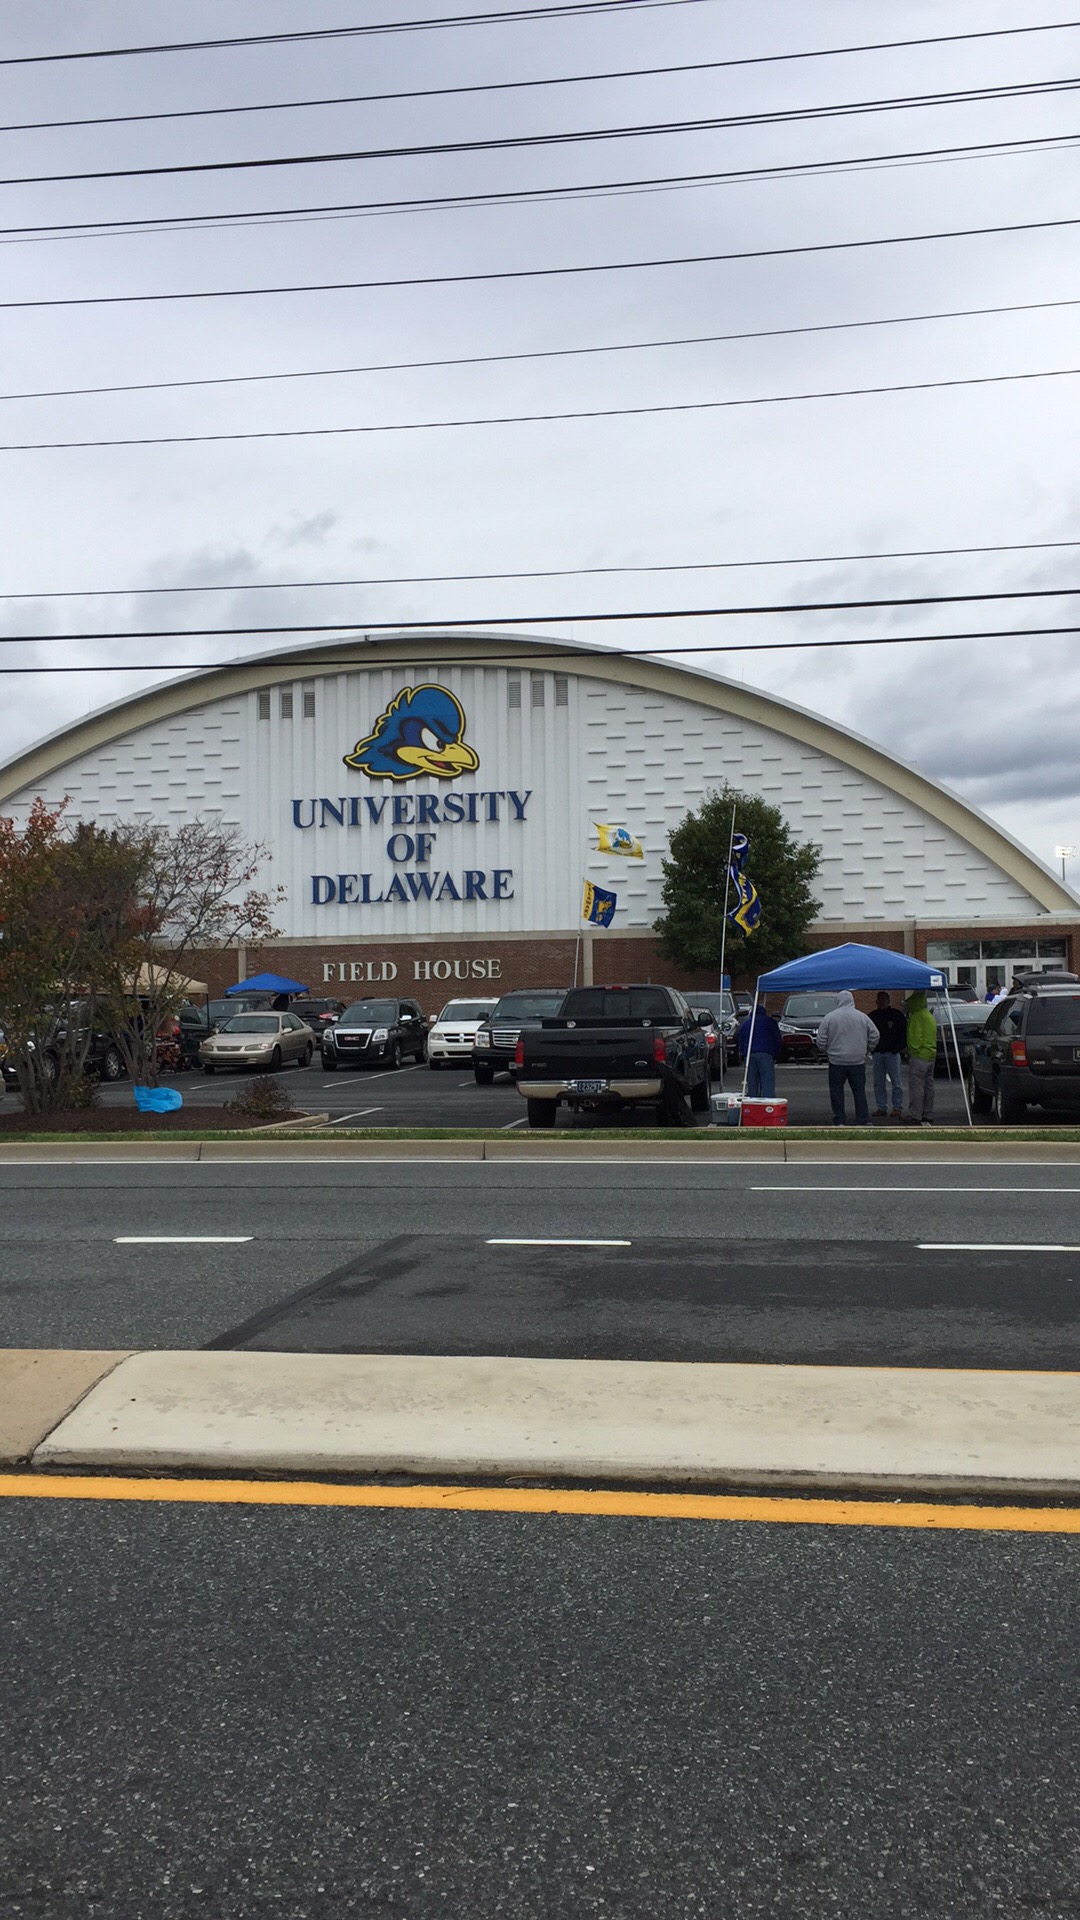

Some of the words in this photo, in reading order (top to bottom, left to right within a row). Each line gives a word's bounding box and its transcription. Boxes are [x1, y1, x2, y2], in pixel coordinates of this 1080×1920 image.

[291, 790, 533, 829] UNIVERSITY
[386, 832, 437, 862] OF
[311, 869, 515, 905] DELAWARE
[322, 961, 398, 982] FIELD
[413, 958, 503, 980] HOUSE
